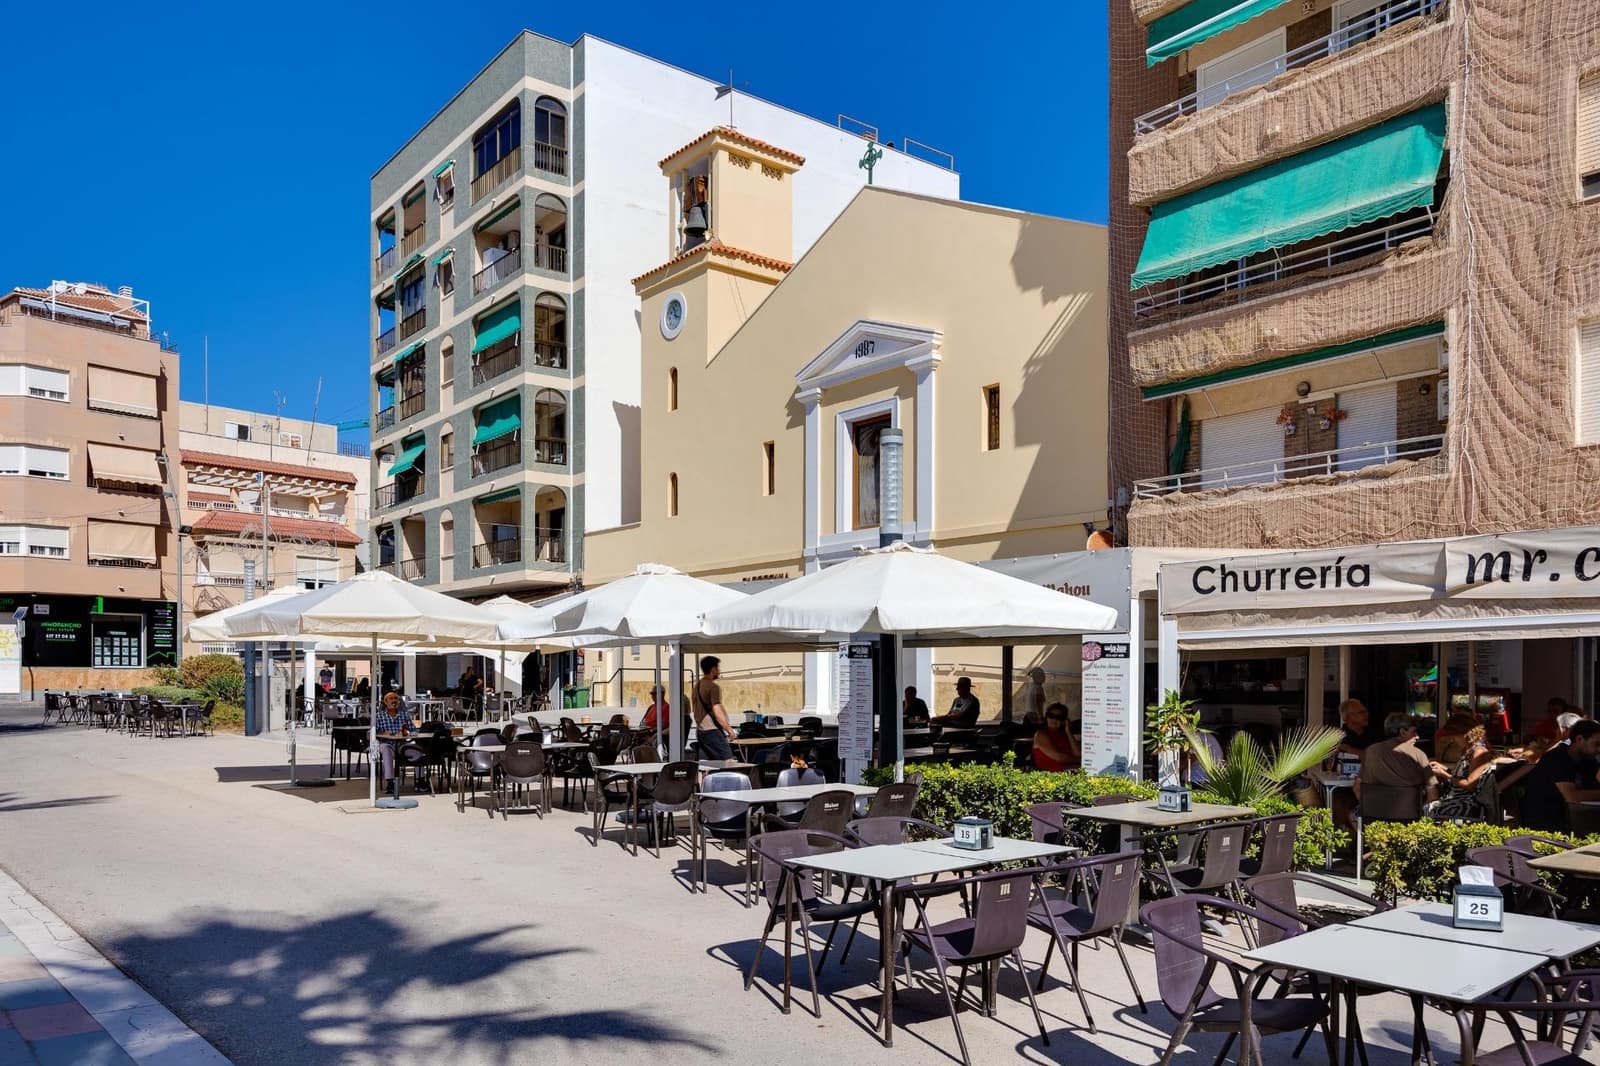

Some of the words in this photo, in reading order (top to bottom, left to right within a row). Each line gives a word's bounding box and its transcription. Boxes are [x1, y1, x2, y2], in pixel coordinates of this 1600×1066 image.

[856, 340, 875, 359] 1987
[1192, 556, 1370, 595] Churrería
[961, 829, 970, 839] 15
[1470, 903, 1489, 916] 25
